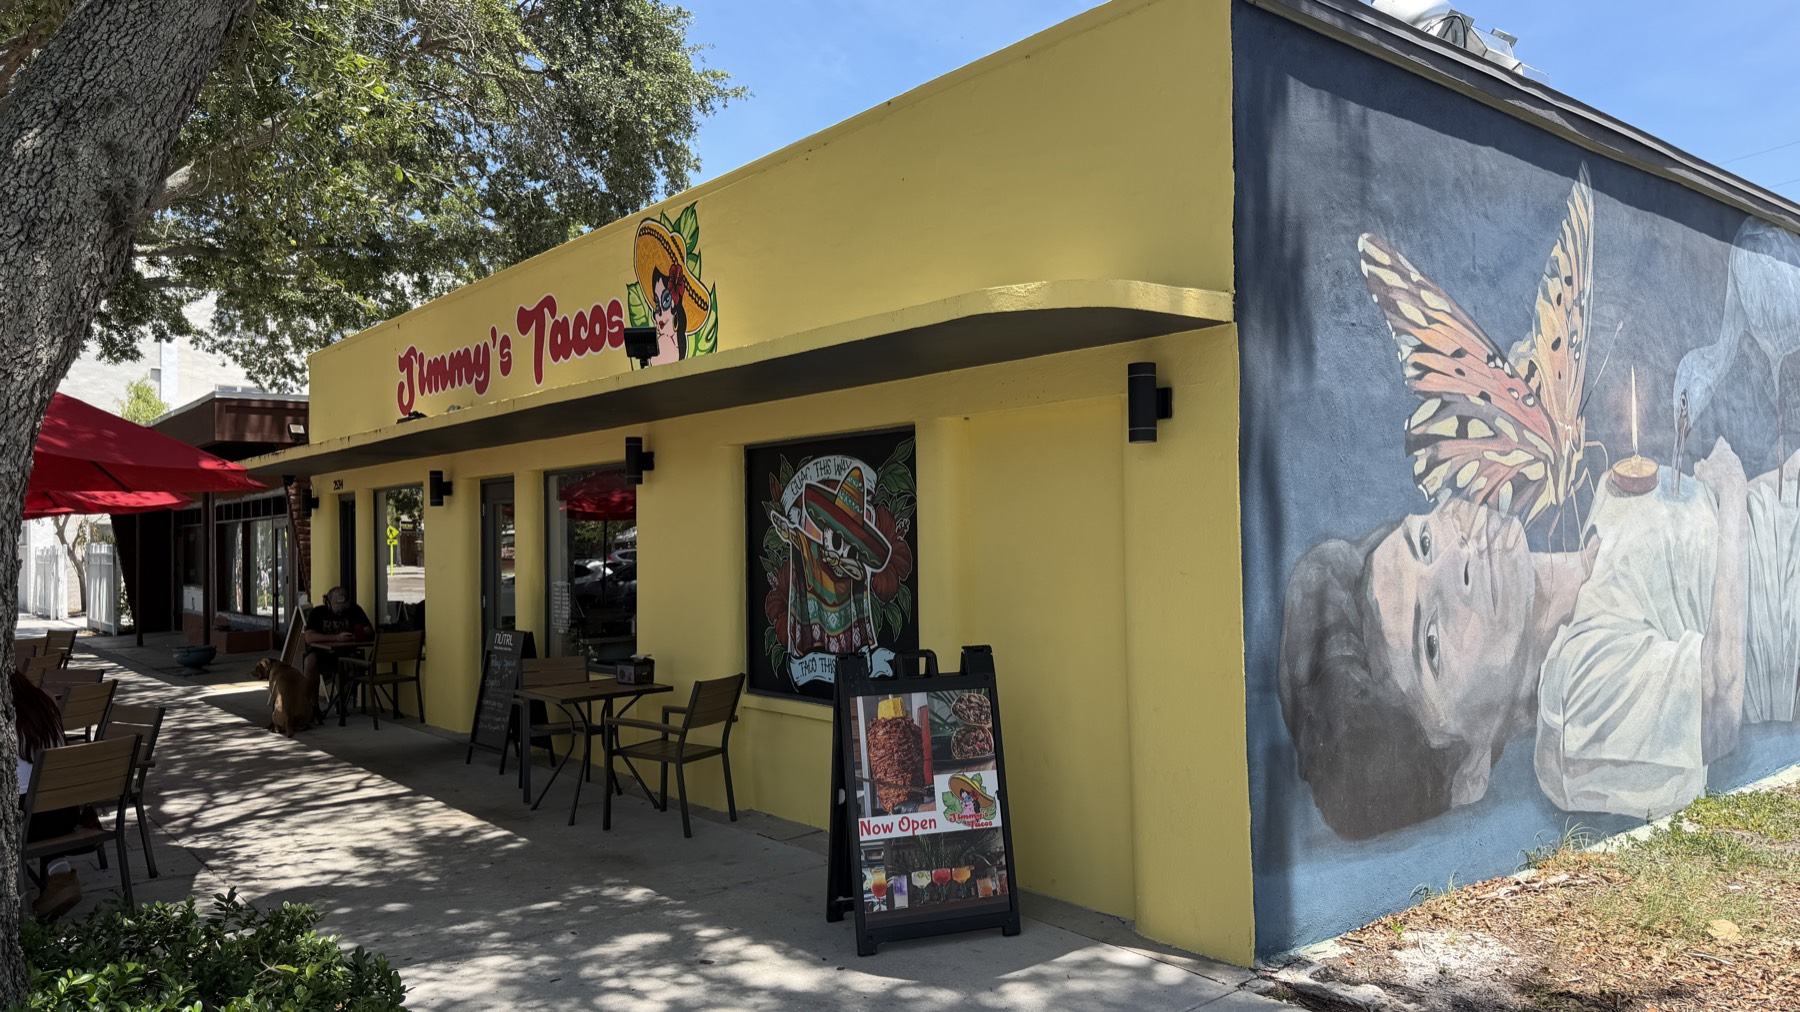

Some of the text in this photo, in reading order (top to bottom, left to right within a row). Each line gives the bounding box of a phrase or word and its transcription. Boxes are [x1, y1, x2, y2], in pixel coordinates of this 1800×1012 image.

[396, 293, 625, 417] Jimmy's Tacos
[813, 458, 832, 478] THIS
[799, 657, 818, 677] TACO
[859, 816, 937, 836] Now Open
